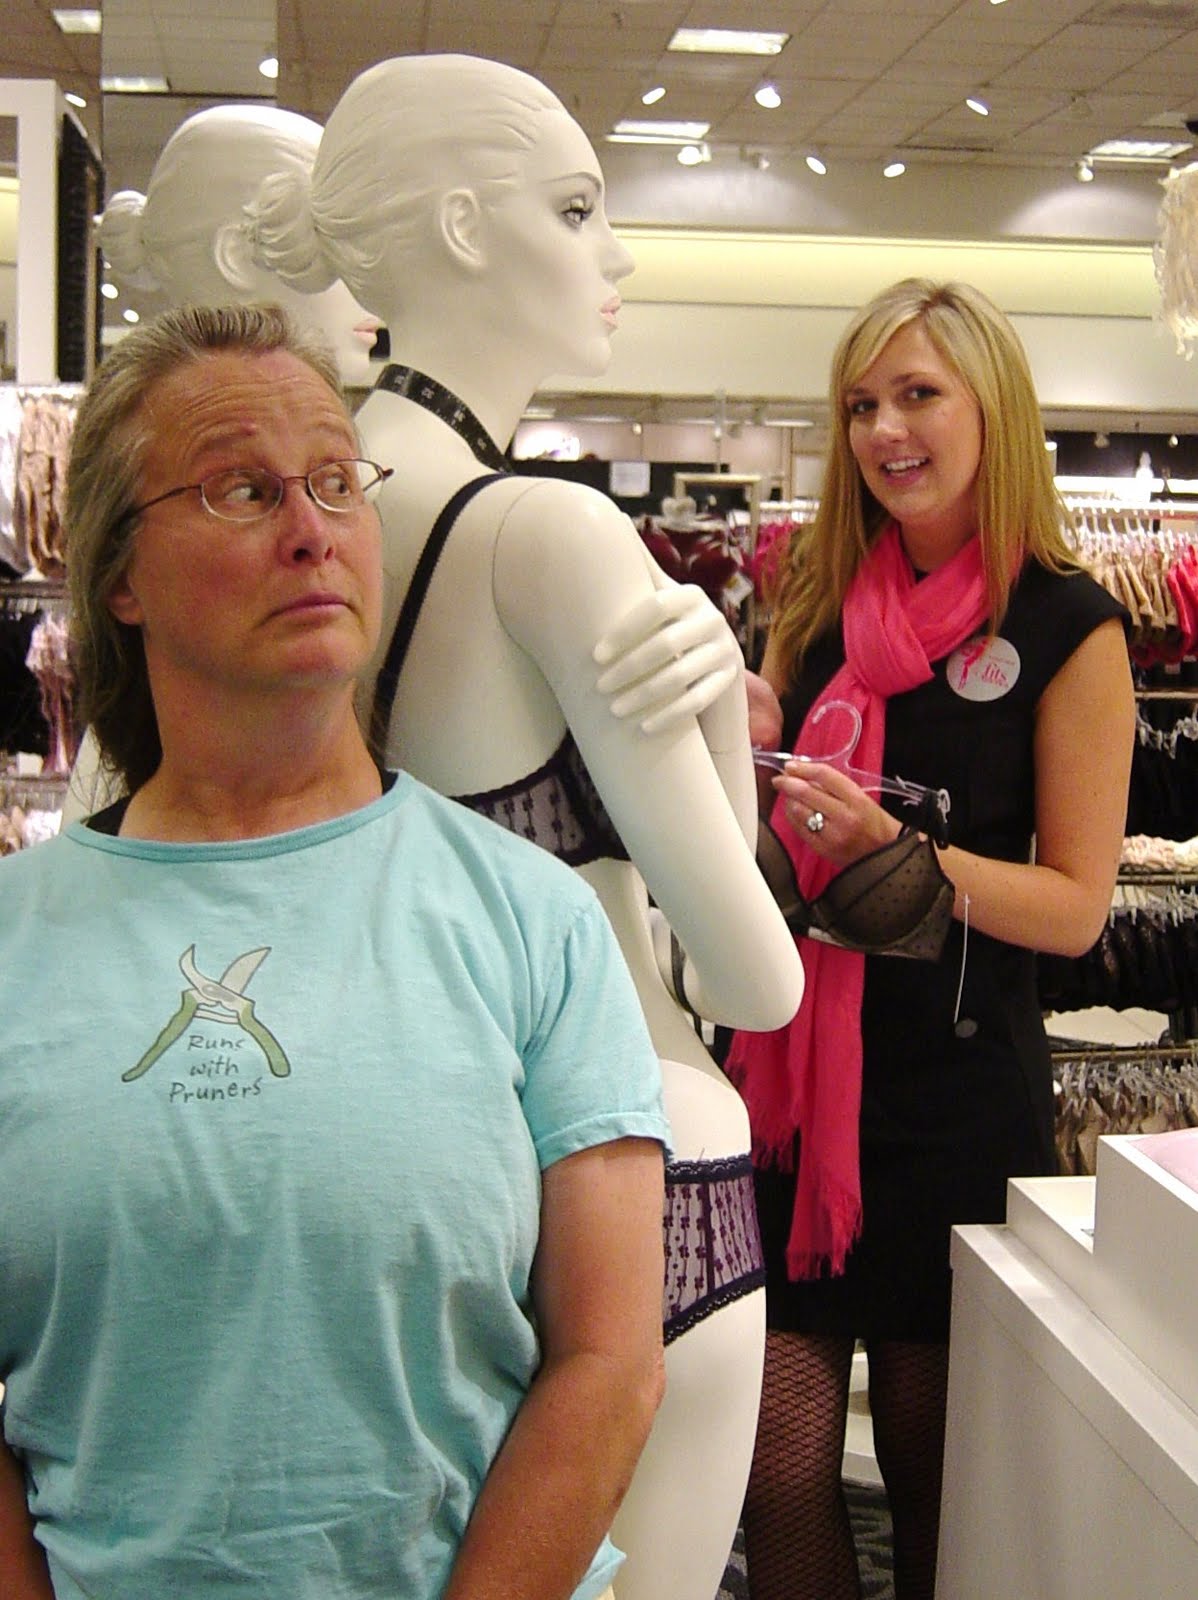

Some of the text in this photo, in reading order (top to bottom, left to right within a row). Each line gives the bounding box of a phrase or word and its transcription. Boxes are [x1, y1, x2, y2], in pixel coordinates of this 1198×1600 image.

[187, 1034, 245, 1051] Runs
[189, 1055, 239, 1078] with
[169, 1076, 263, 1103] Pruners
